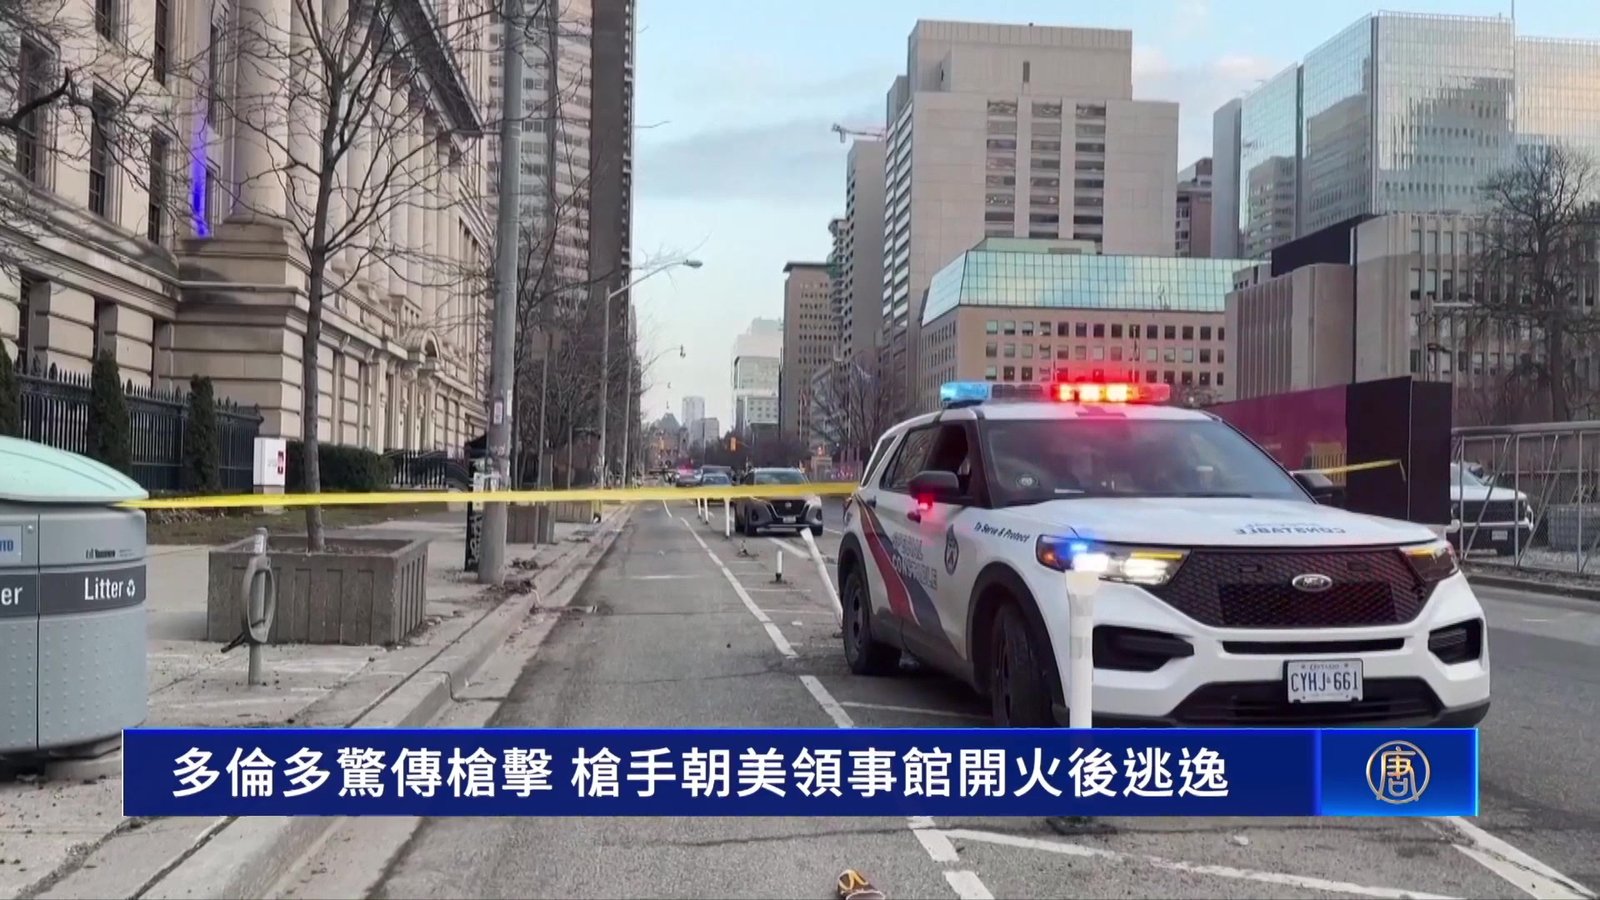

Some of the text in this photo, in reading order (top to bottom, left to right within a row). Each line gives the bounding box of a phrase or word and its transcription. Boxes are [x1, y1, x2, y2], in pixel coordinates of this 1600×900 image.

[983, 523, 998, 535] Serve
[1003, 529, 1030, 542] Protect
[85, 577, 123, 601] Litter
